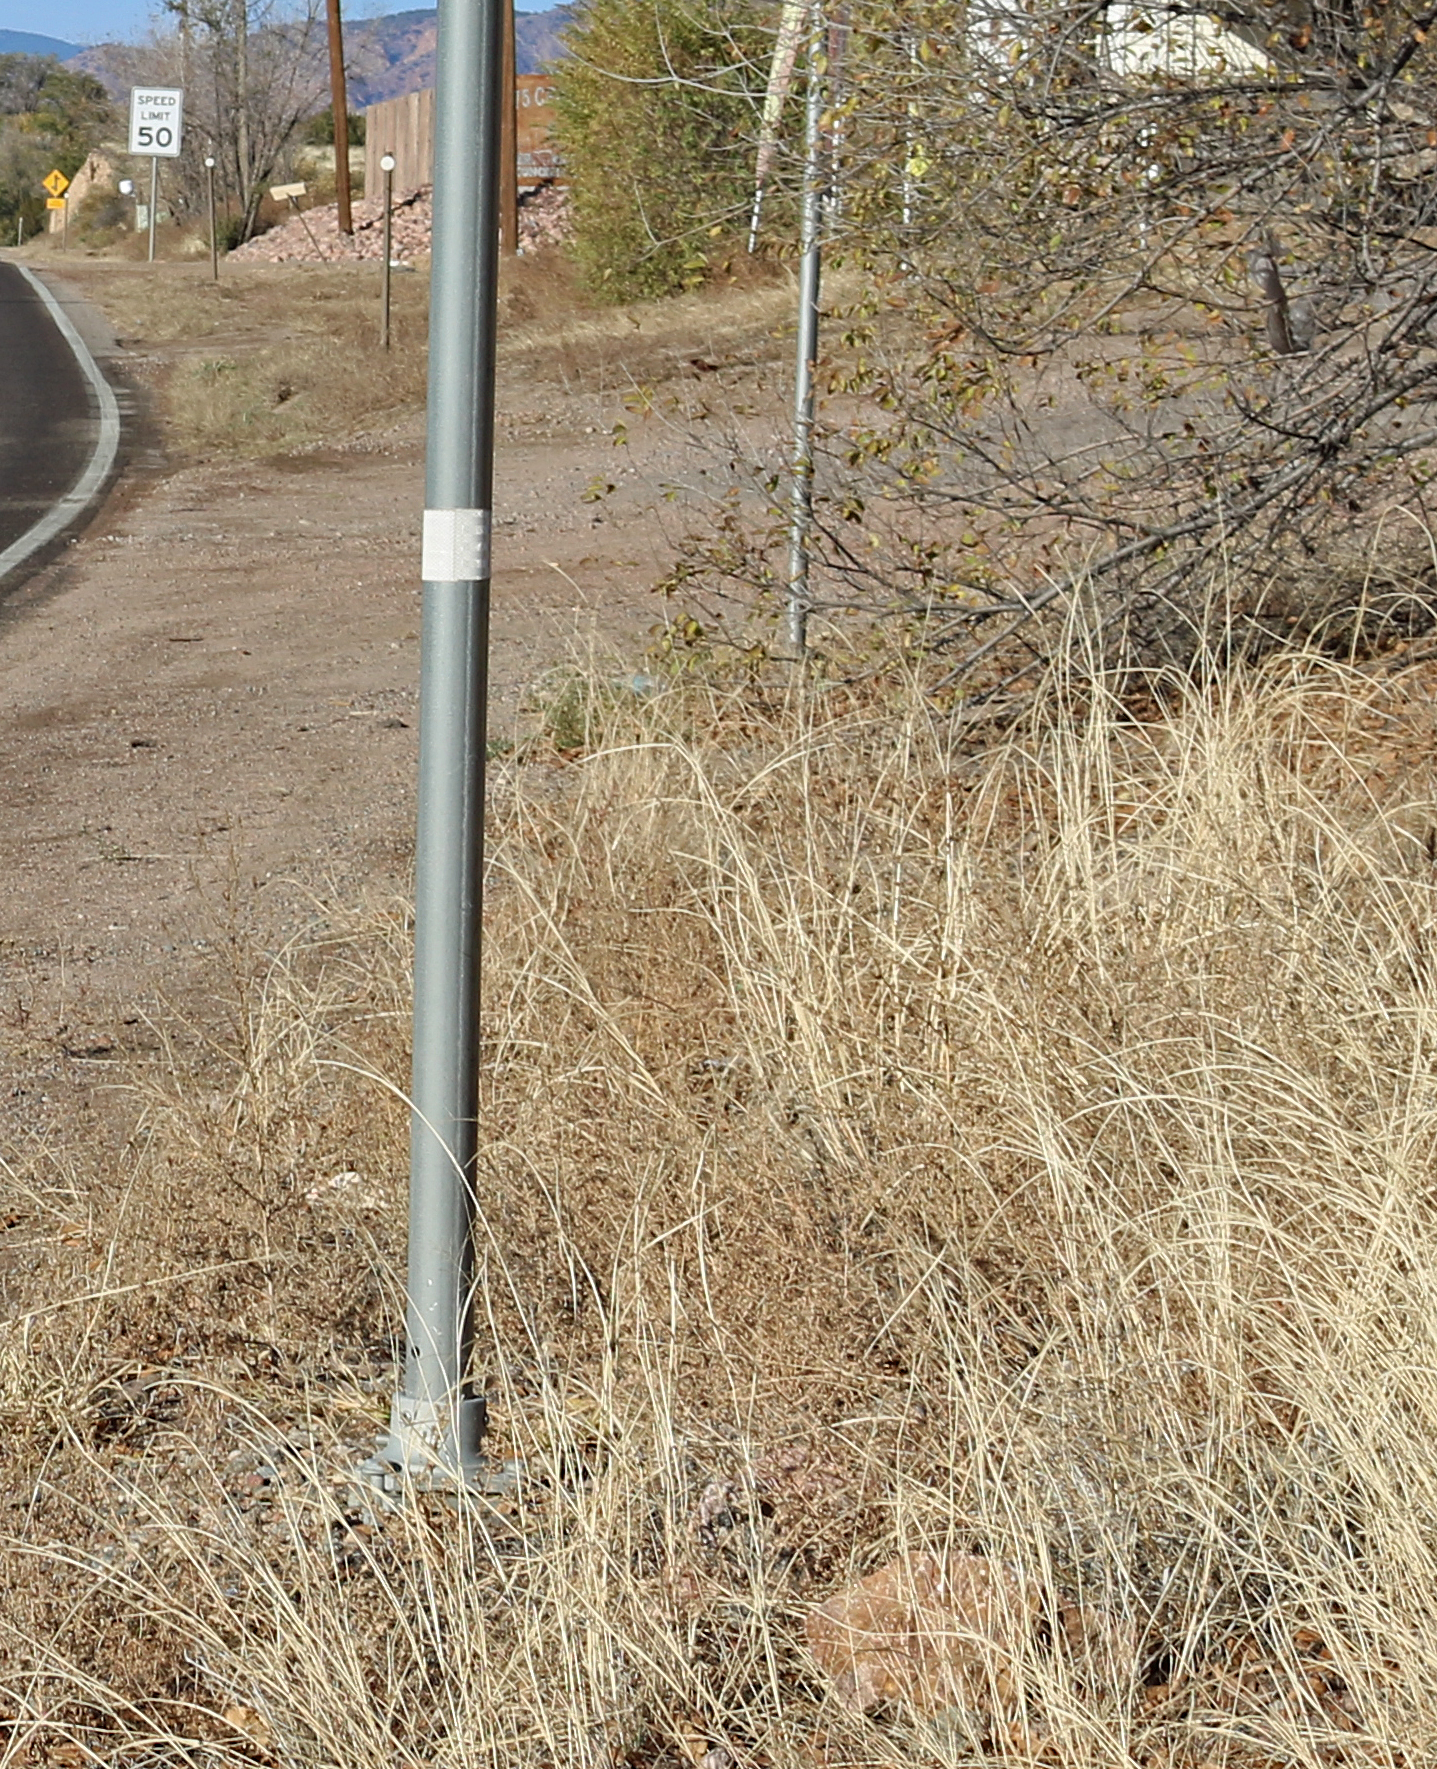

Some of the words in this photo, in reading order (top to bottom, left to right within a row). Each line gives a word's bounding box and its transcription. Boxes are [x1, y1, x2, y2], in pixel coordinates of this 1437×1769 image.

[137, 95, 176, 106] SPEED
[141, 111, 171, 121] LIMIT
[137, 126, 173, 147] 50
